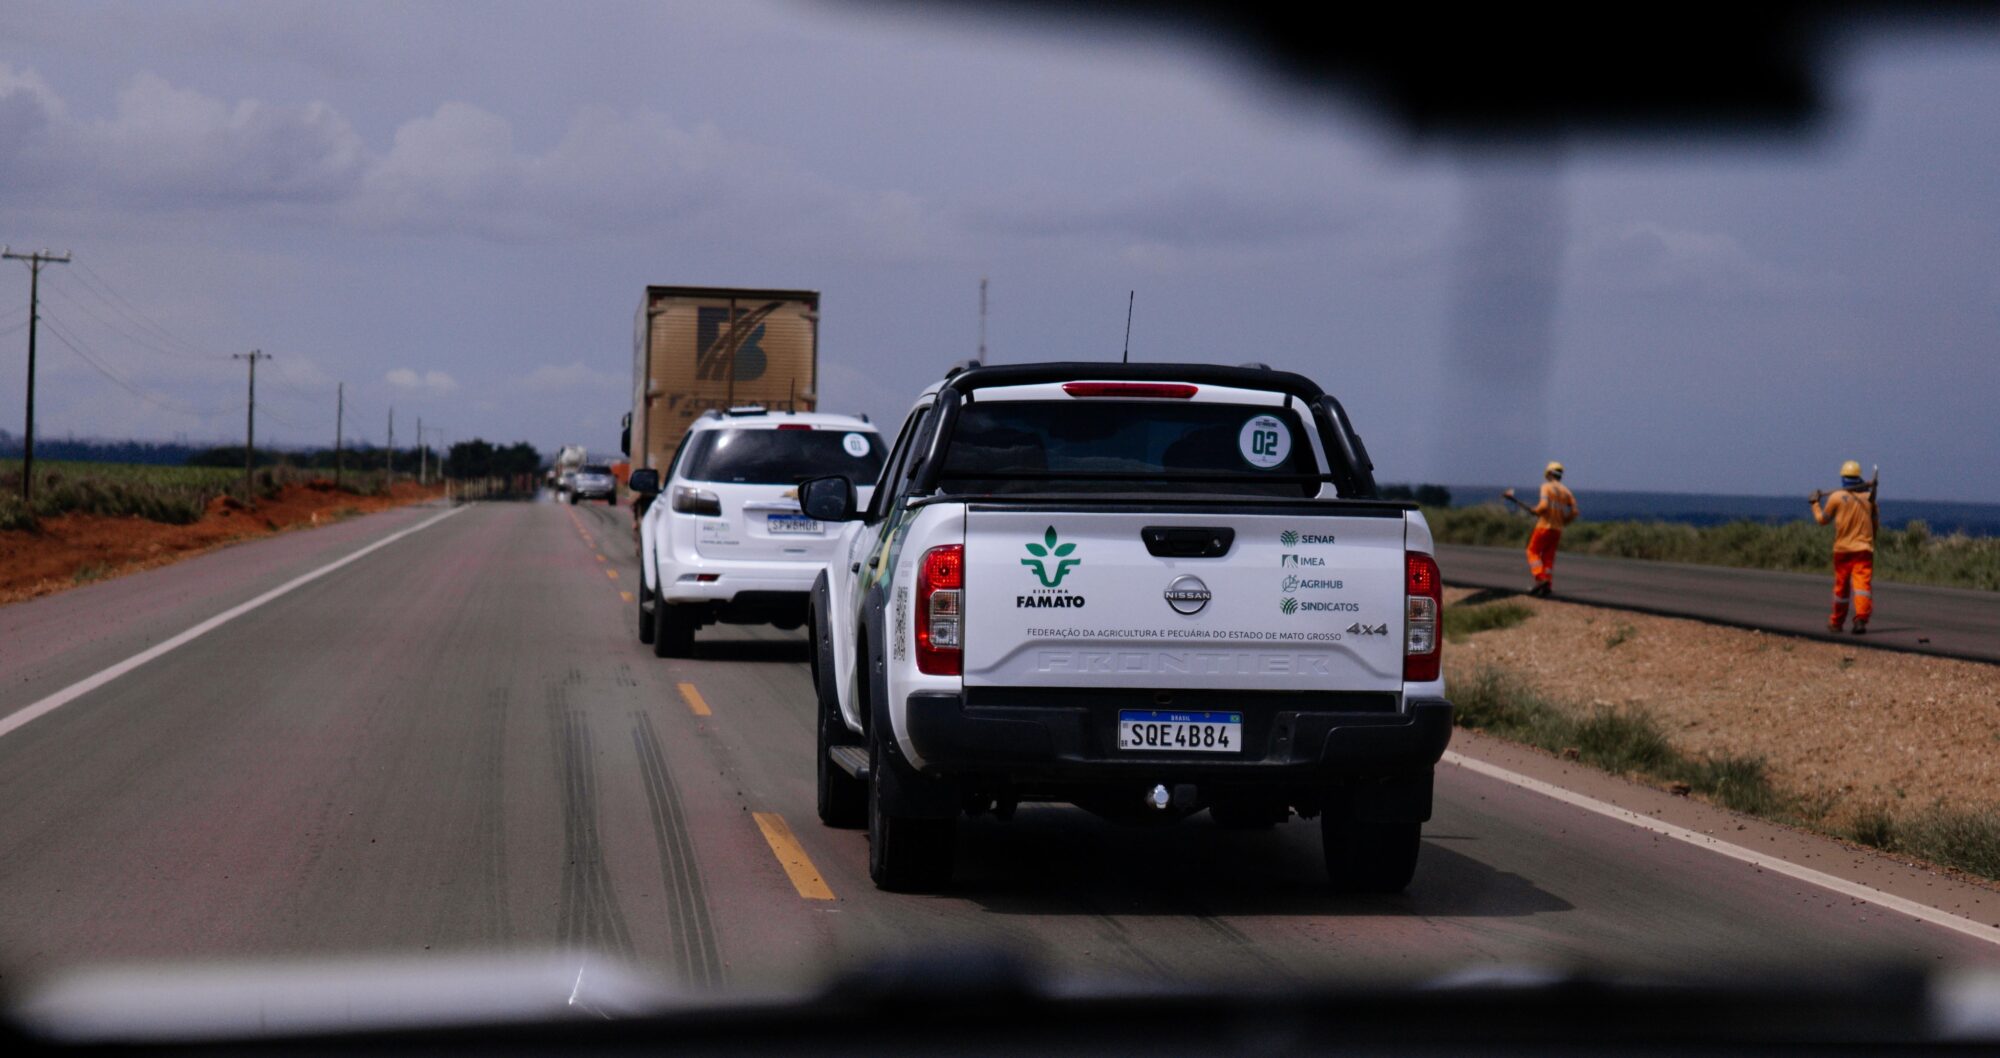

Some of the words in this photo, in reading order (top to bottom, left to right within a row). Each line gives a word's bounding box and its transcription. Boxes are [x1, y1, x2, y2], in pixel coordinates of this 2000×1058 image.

[1252, 430, 1278, 456] 02
[1301, 535, 1335, 544] SENAR
[1300, 557, 1325, 566] IMEA
[1300, 580, 1343, 589] AGRIHUB
[1166, 592, 1211, 600] NISSAN
[1016, 596, 1085, 608] FAMATO
[1301, 602, 1359, 612] SINDICATOS
[1027, 628, 1080, 638] FEDERAÇÃO
[1082, 629, 1095, 637] DA
[1097, 629, 1157, 638] AGRICULTURA
[1160, 630, 1165, 638] E
[1167, 628, 1211, 638] PECUÁRIA
[1213, 630, 1226, 639] DO
[1229, 631, 1263, 639] ESTADO
[1265, 632, 1277, 640] DE
[1279, 632, 1304, 640] MATO
[1306, 633, 1341, 641] GROSSO
[1131, 724, 1229, 748] SQE4B84
